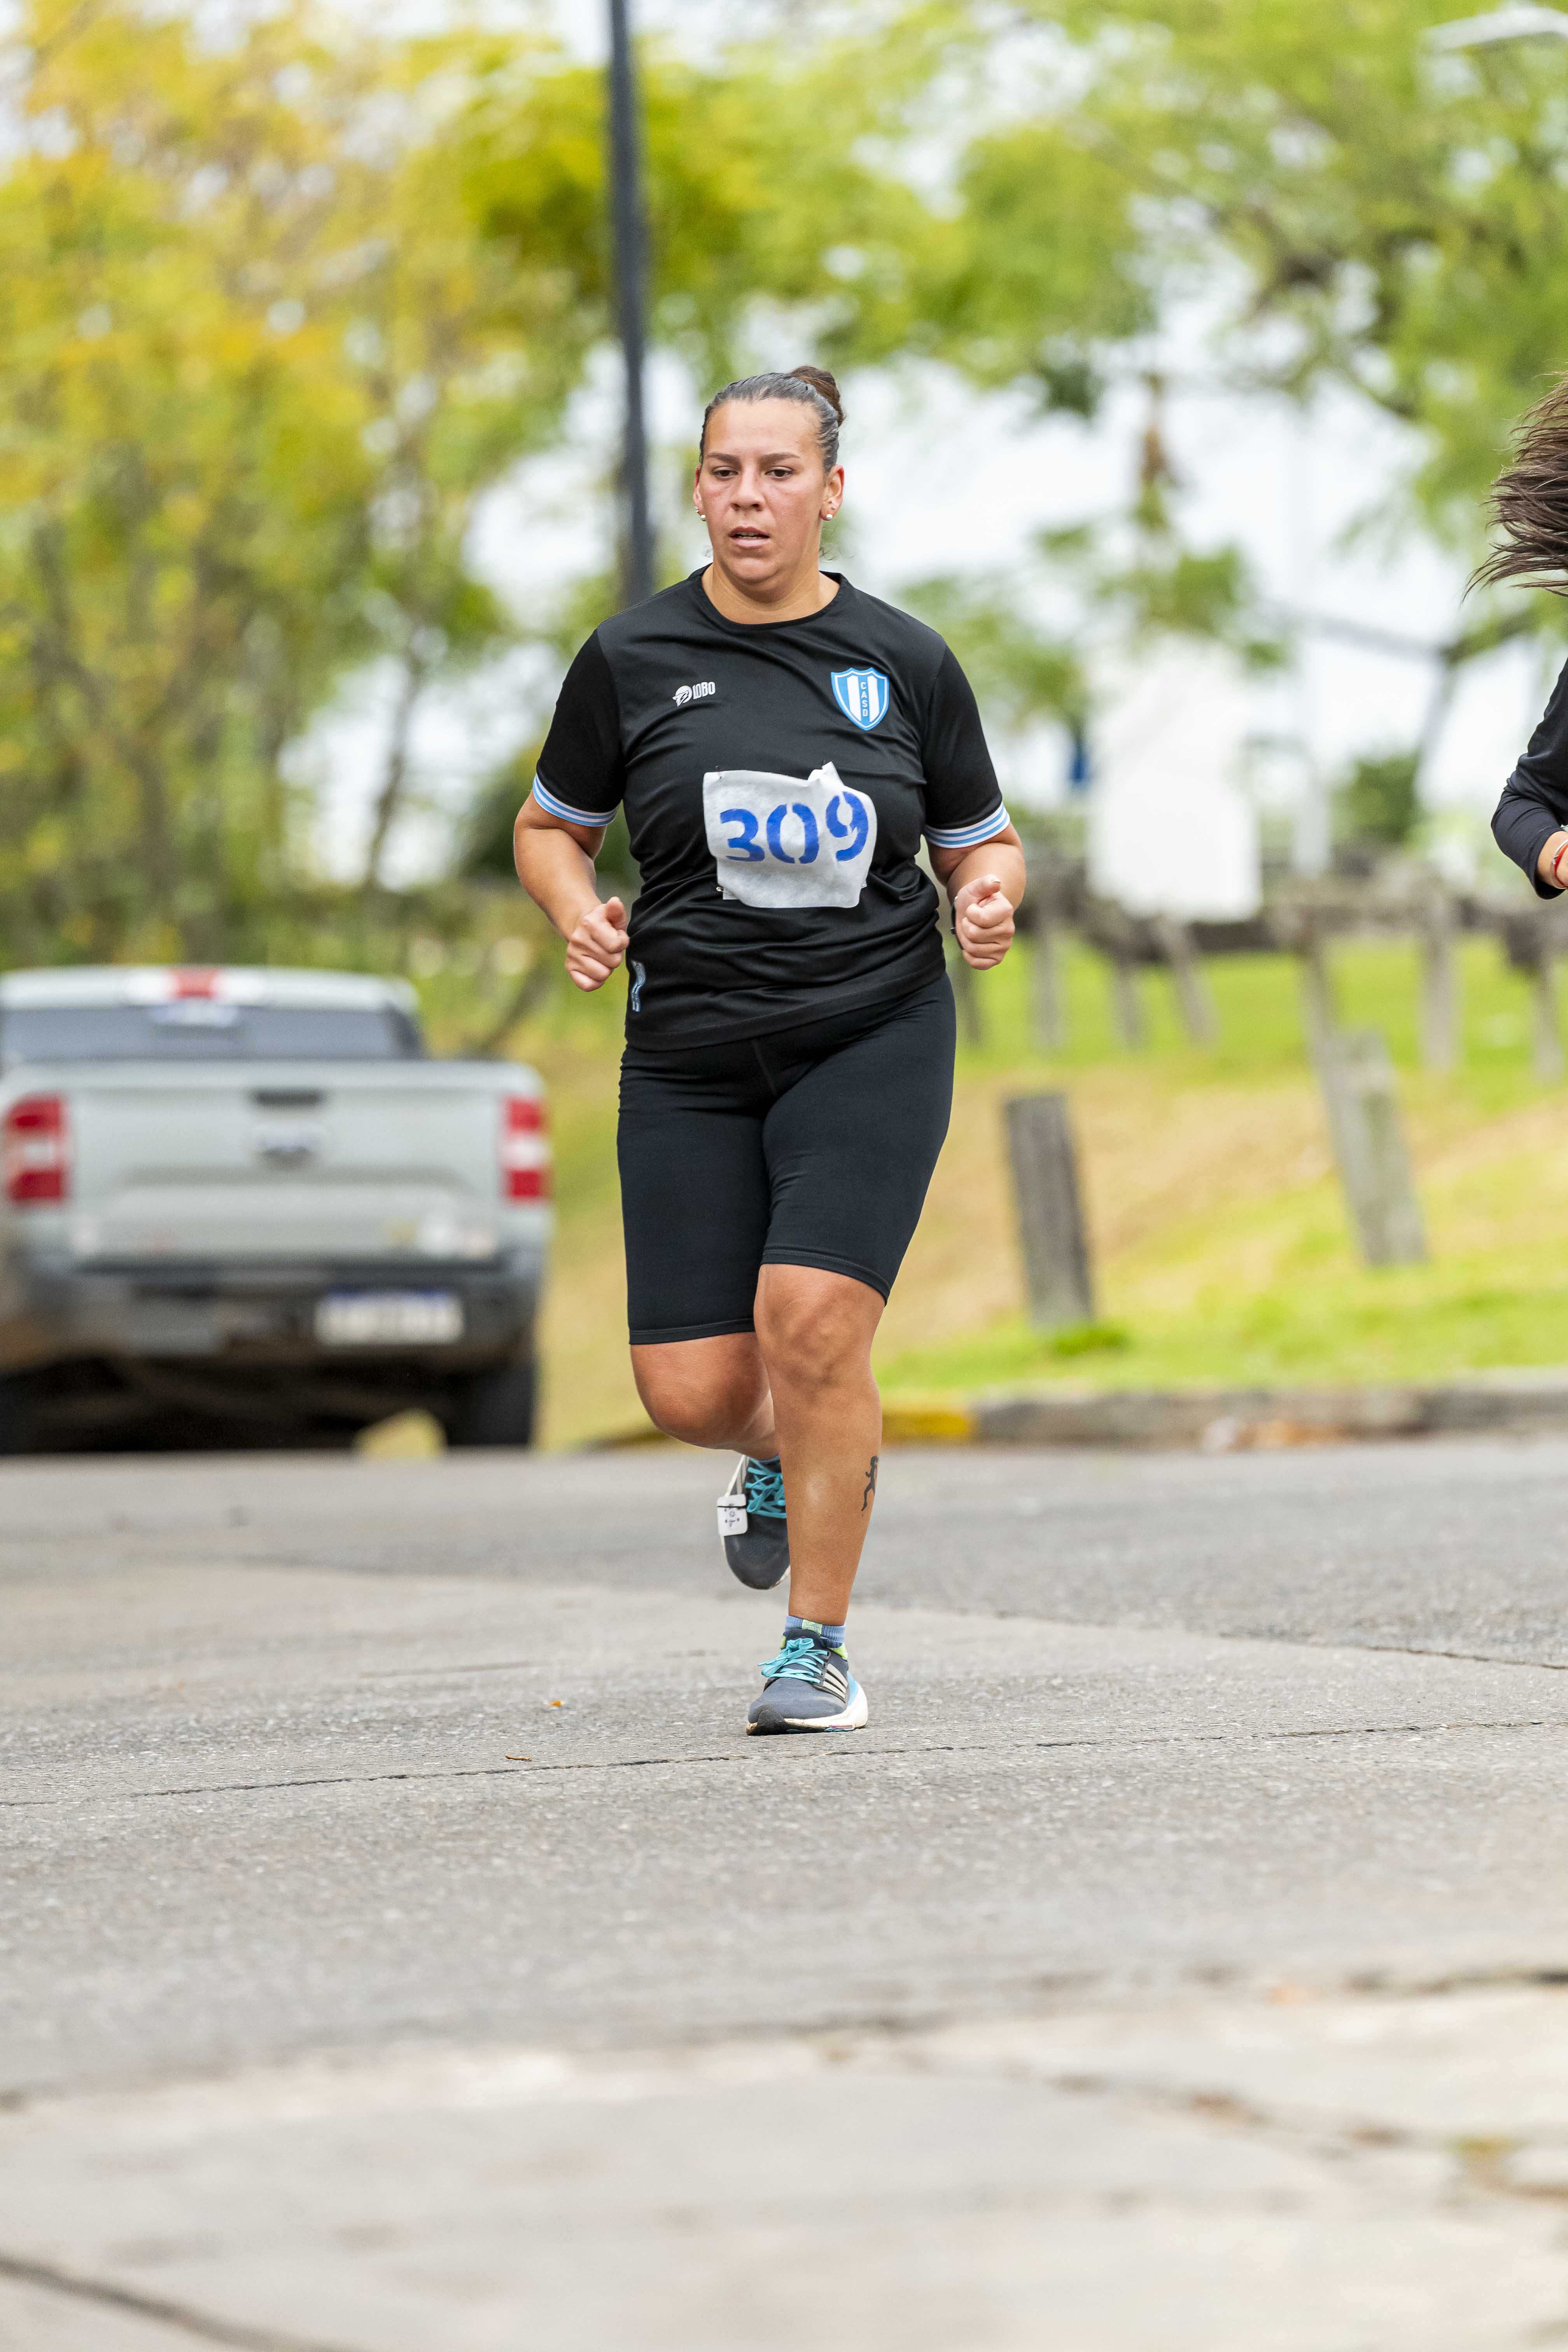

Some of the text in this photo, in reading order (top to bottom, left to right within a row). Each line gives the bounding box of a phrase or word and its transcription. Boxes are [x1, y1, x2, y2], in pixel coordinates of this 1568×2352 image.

[693, 682, 716, 699] LOBO
[860, 682, 868, 717] CASD
[719, 791, 868, 864] 309
